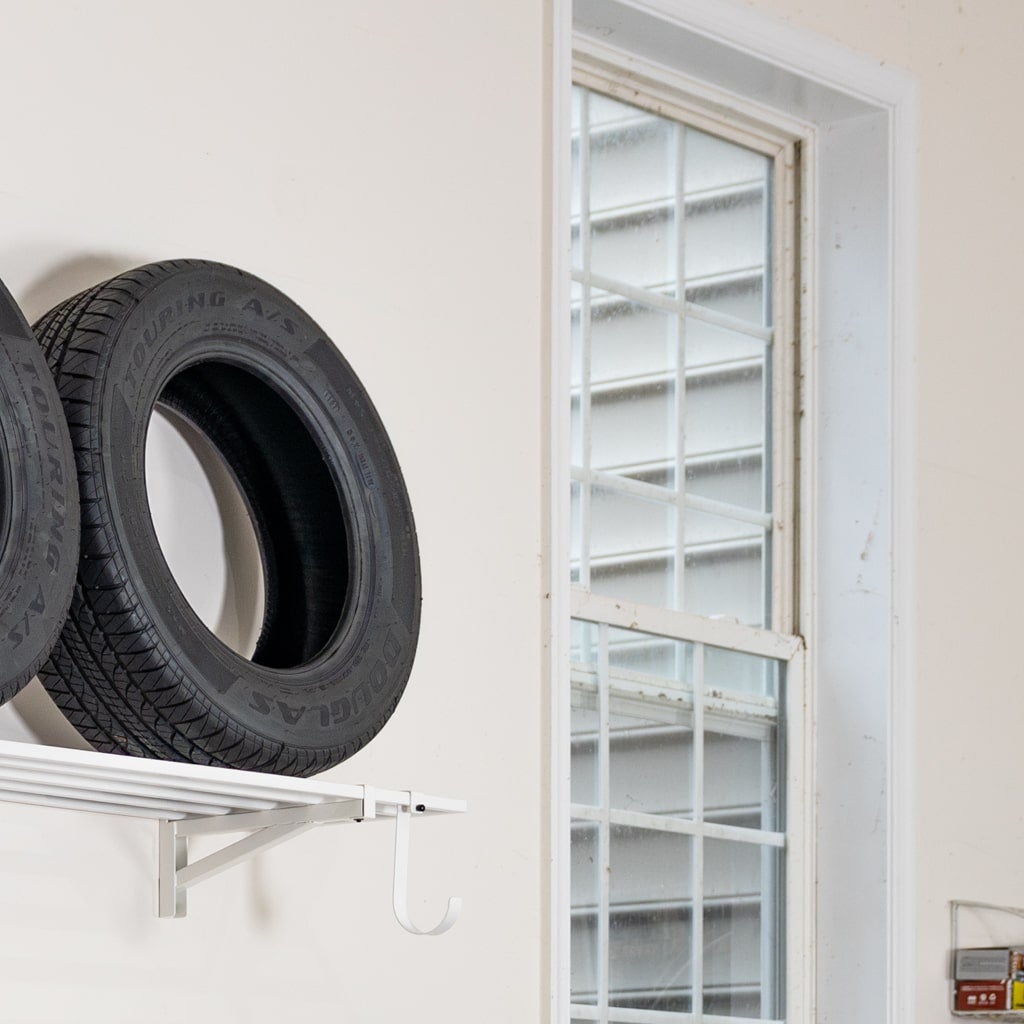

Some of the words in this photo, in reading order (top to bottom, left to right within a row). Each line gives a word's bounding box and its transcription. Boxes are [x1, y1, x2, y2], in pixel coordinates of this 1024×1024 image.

[124, 291, 226, 389] TOURING
[22, 356, 66, 574] TOURING
[248, 627, 402, 728] DOUGLAS
